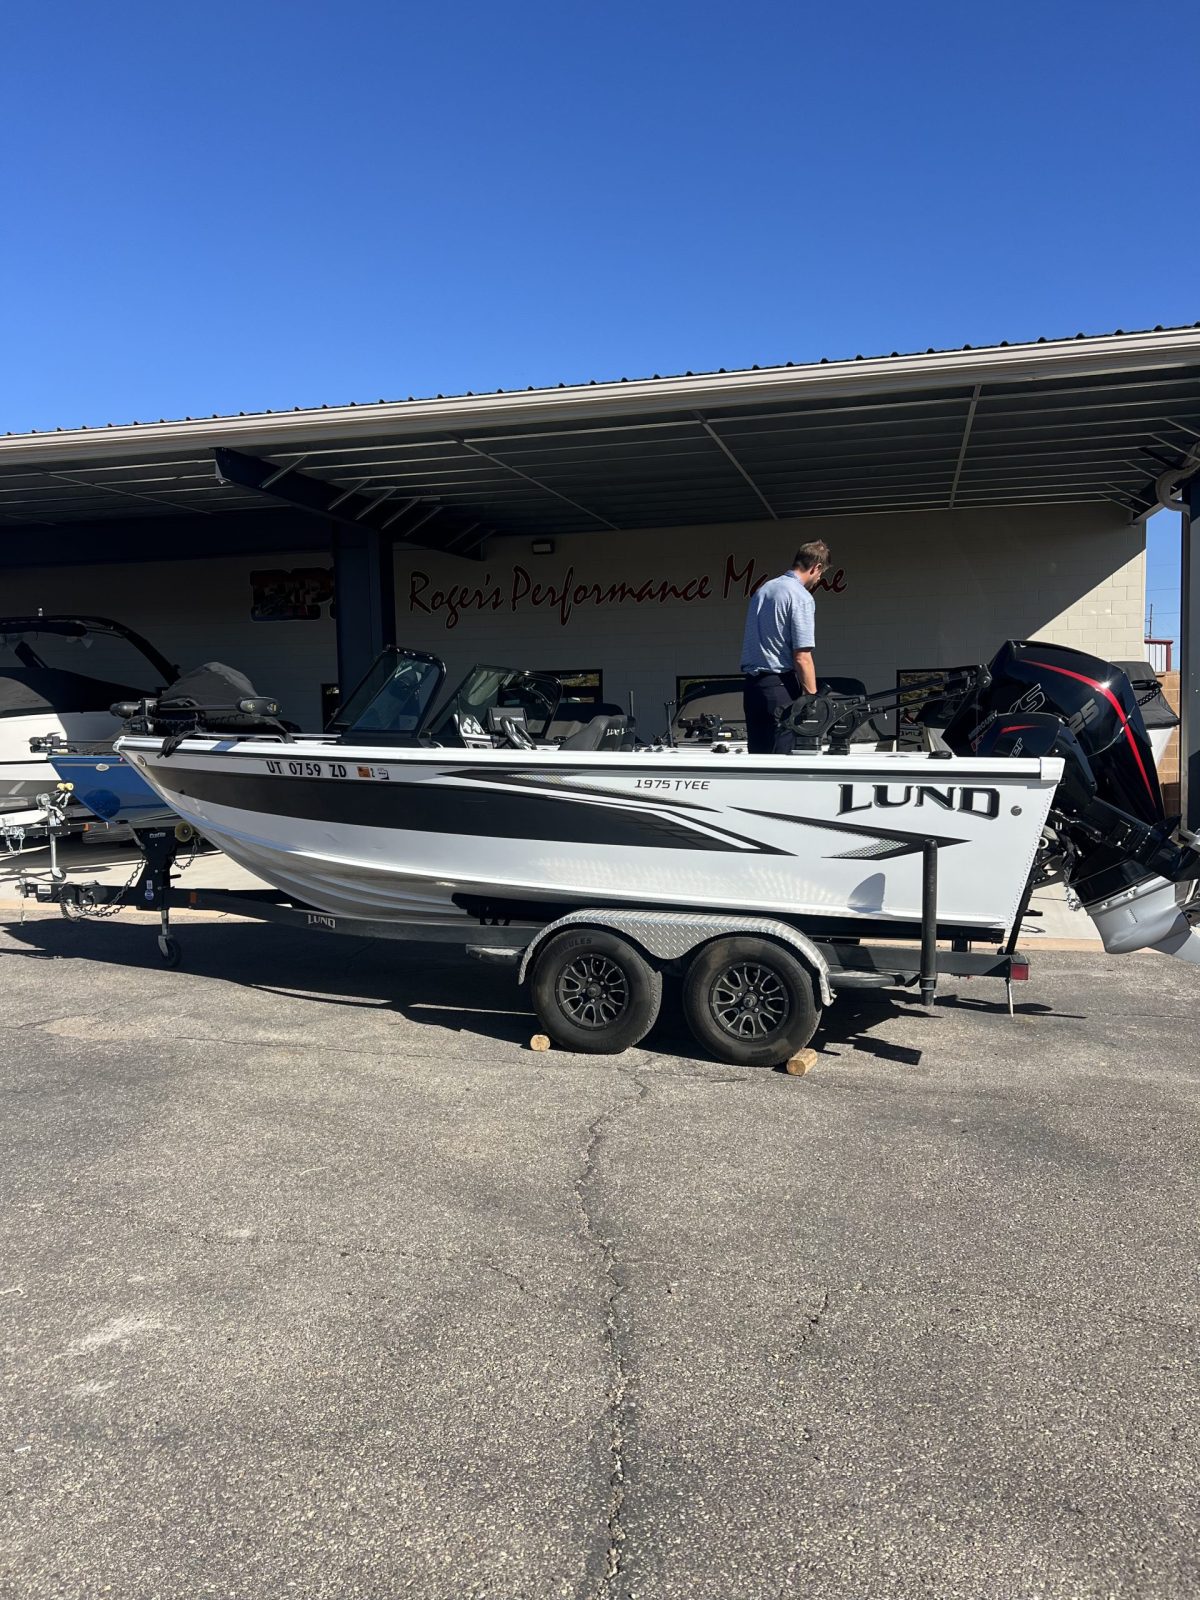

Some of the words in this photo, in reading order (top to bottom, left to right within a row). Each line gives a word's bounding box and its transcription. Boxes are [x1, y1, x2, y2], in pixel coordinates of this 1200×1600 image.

[408, 570, 504, 629] Roger's
[510, 565, 712, 626] Performance
[266, 761, 282, 774] UT
[288, 762, 321, 776] 0759
[328, 764, 347, 778] ZD
[635, 779, 671, 789] 1975
[674, 780, 711, 791] TYEE
[836, 784, 999, 820] LUND
[307, 914, 336, 929] LUND
